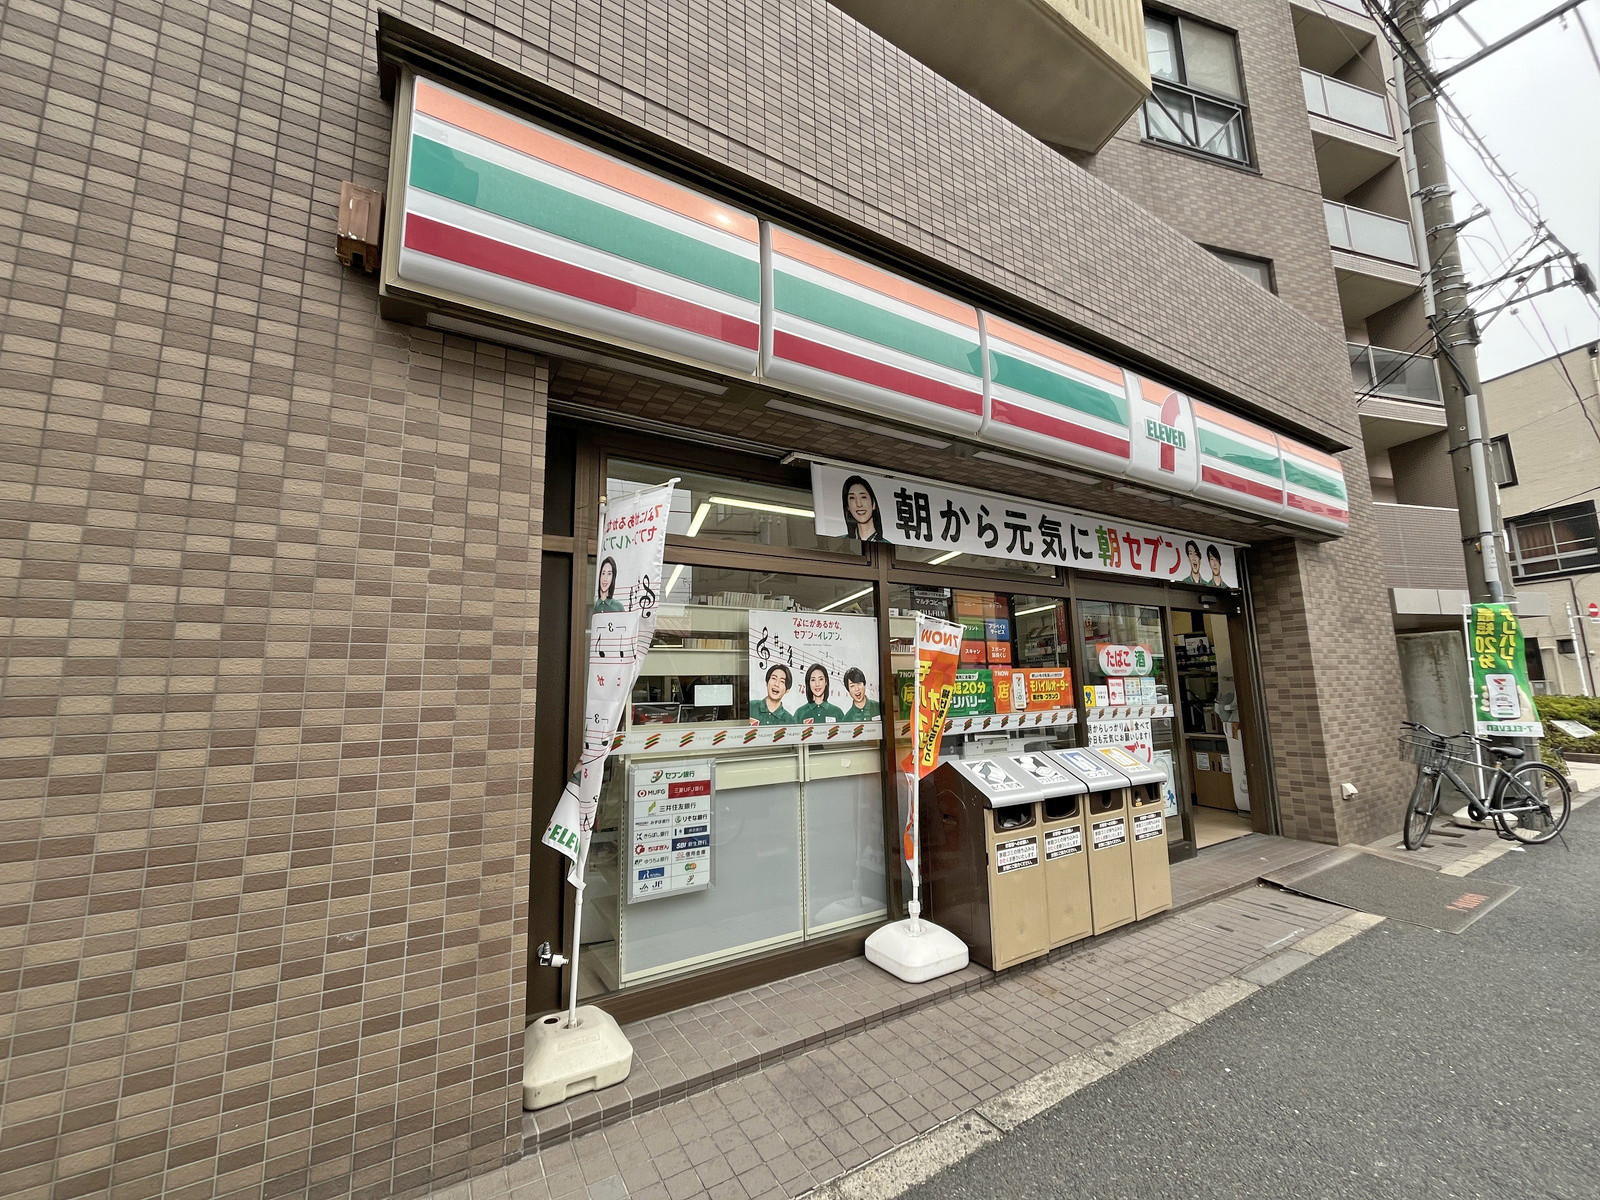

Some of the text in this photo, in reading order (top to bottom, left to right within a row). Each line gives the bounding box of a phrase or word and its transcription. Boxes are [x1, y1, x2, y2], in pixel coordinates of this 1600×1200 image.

[893, 487, 1183, 575] 朝から元気に朝セブン
[1105, 649, 1146, 668] たばこ 酒
[1029, 680, 1070, 693] モバイルオーダー
[950, 695, 987, 708] リバリー
[665, 770, 695, 780] セブン銀行
[647, 788, 666, 796] MUFG
[674, 785, 704, 794] 三菱UFJ銀行
[659, 801, 697, 813] 三井住友銀行
[682, 813, 708, 823] りそな銀行
[647, 844, 670, 852] ちばぎん
[685, 849, 706, 858] 信用金庫
